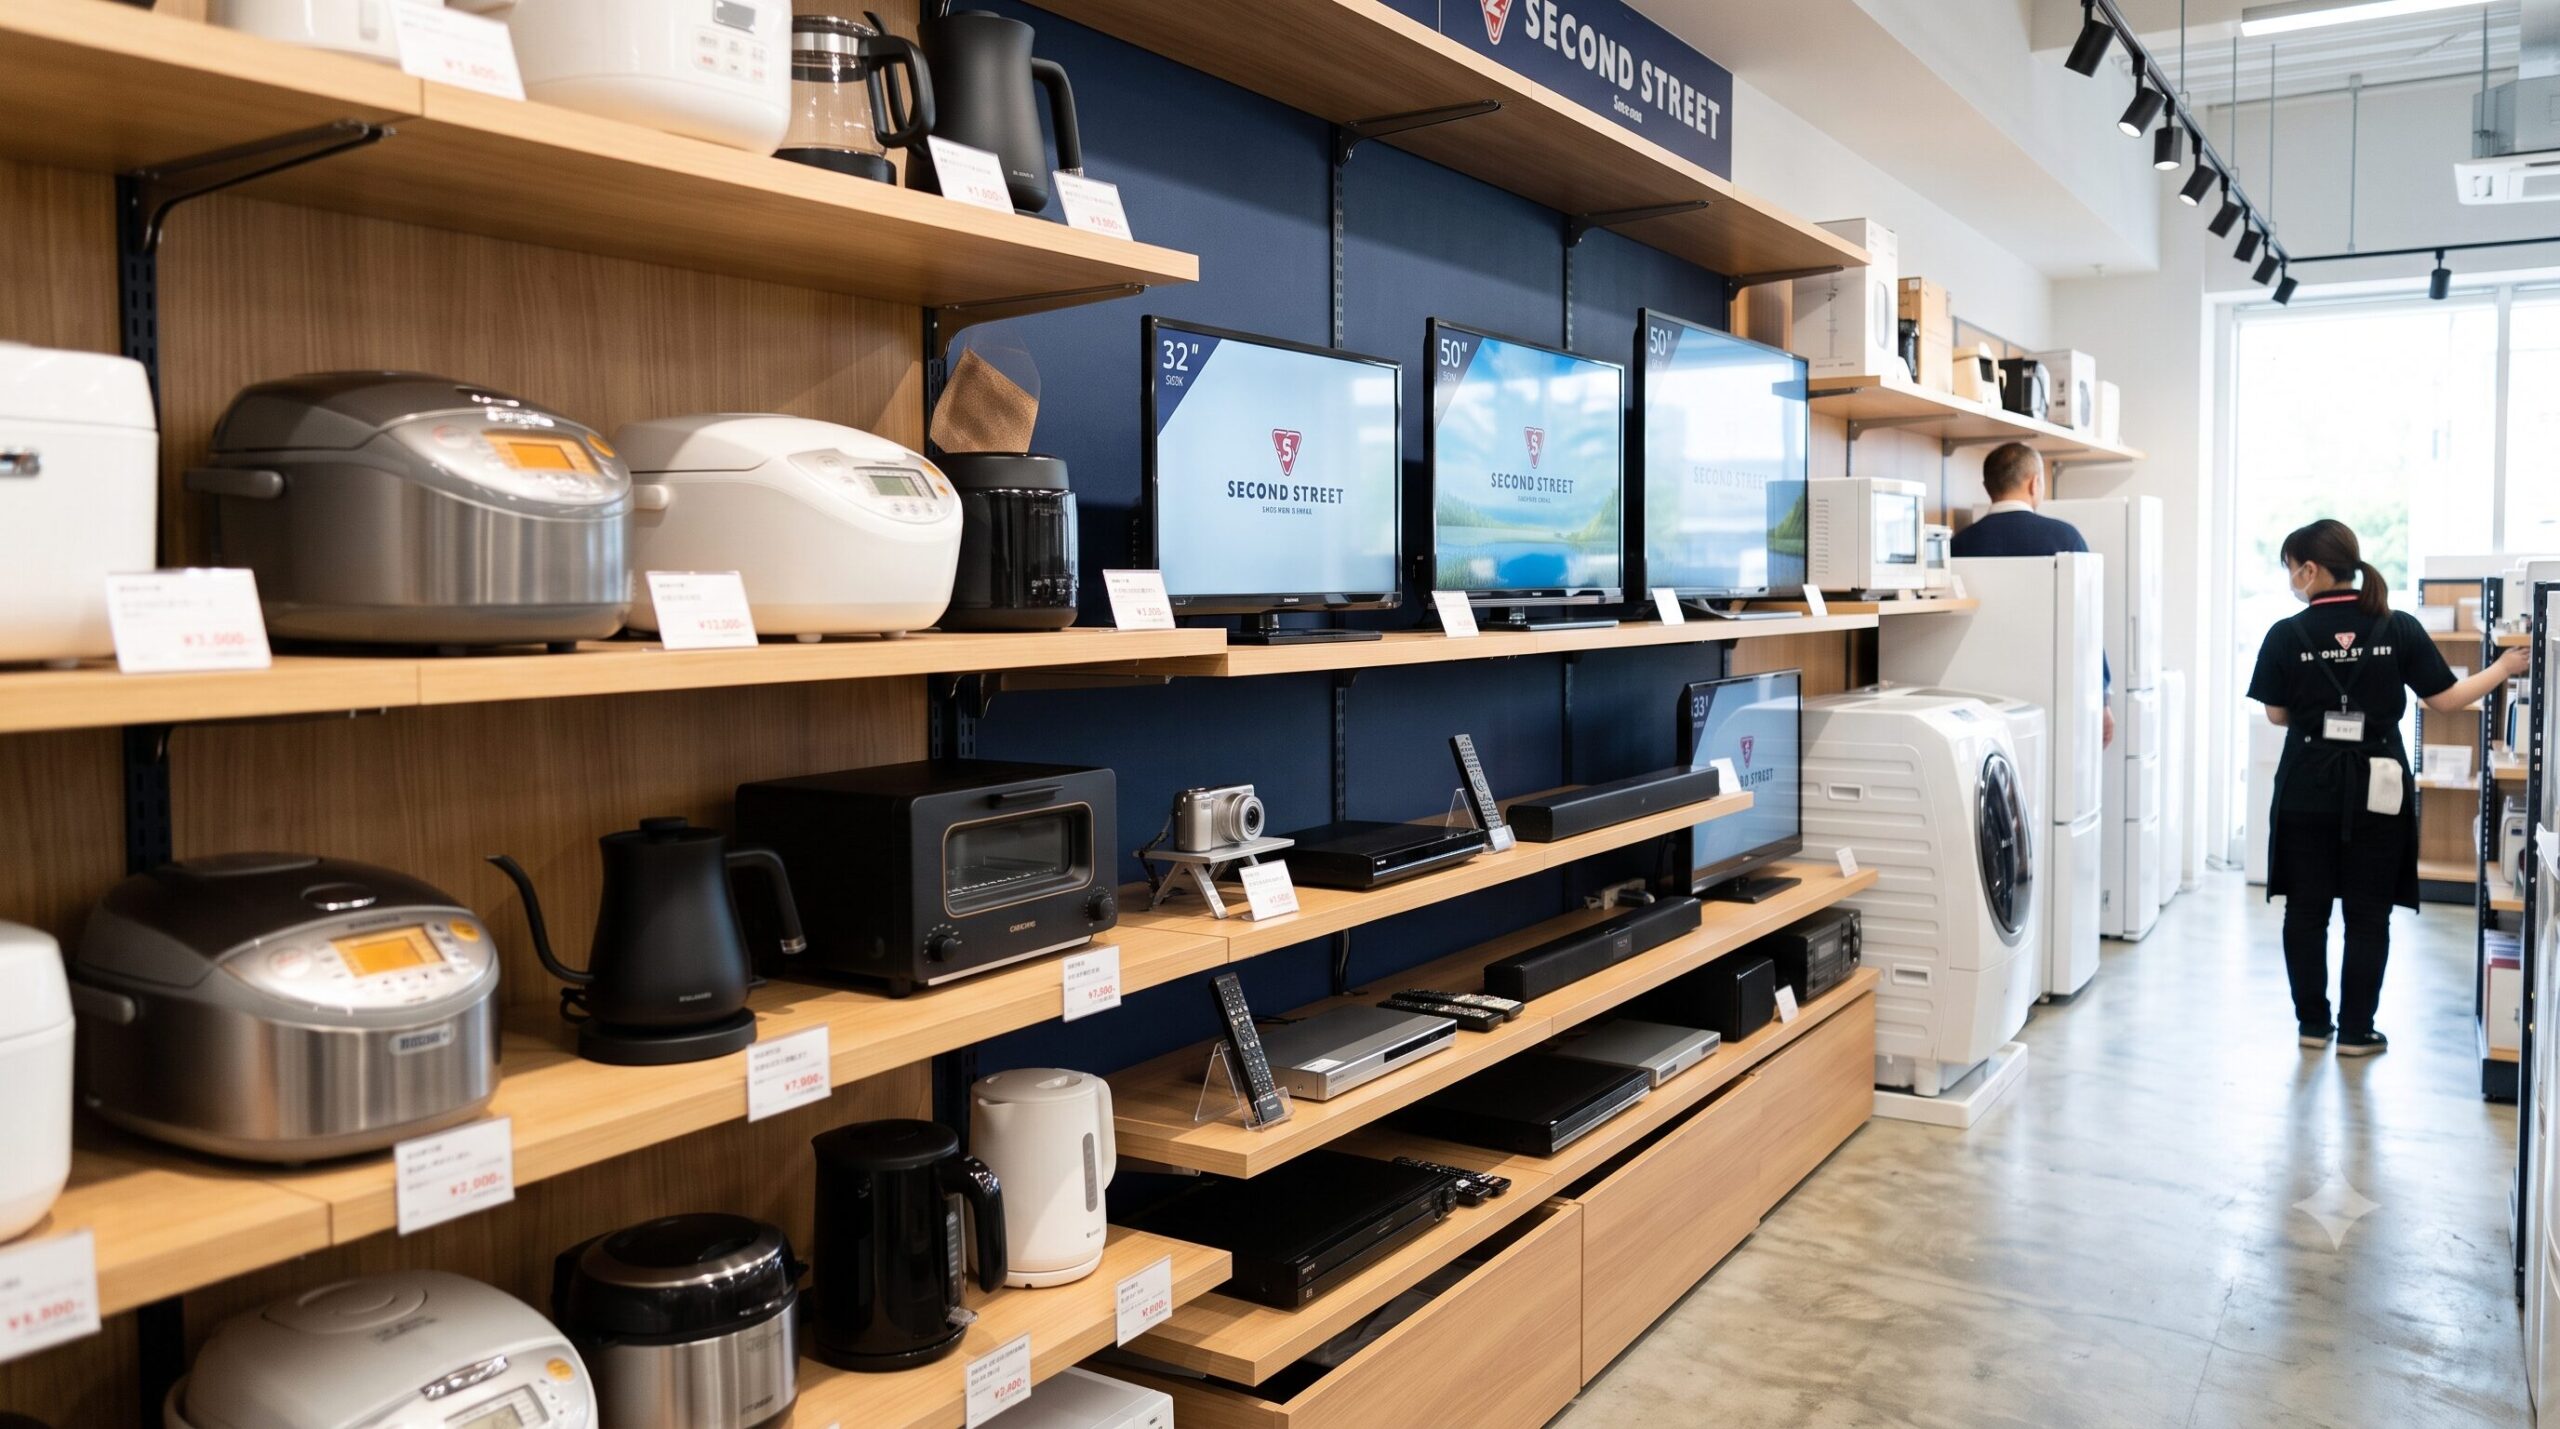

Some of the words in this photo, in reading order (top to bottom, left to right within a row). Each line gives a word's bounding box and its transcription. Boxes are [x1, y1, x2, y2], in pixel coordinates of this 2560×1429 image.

[1525, 0, 1634, 91] SECOND
[1641, 59, 1720, 140] STREET
[1163, 340, 1199, 371] 32"
[1440, 338, 1468, 368] 50"
[1650, 326, 1673, 356] 50"
[1491, 472, 1534, 490] SECOND
[1537, 476, 1574, 494] STREET
[1693, 466, 1733, 487] SECOND
[1227, 480, 1289, 501] SECOND
[1293, 485, 1344, 504] STREET
